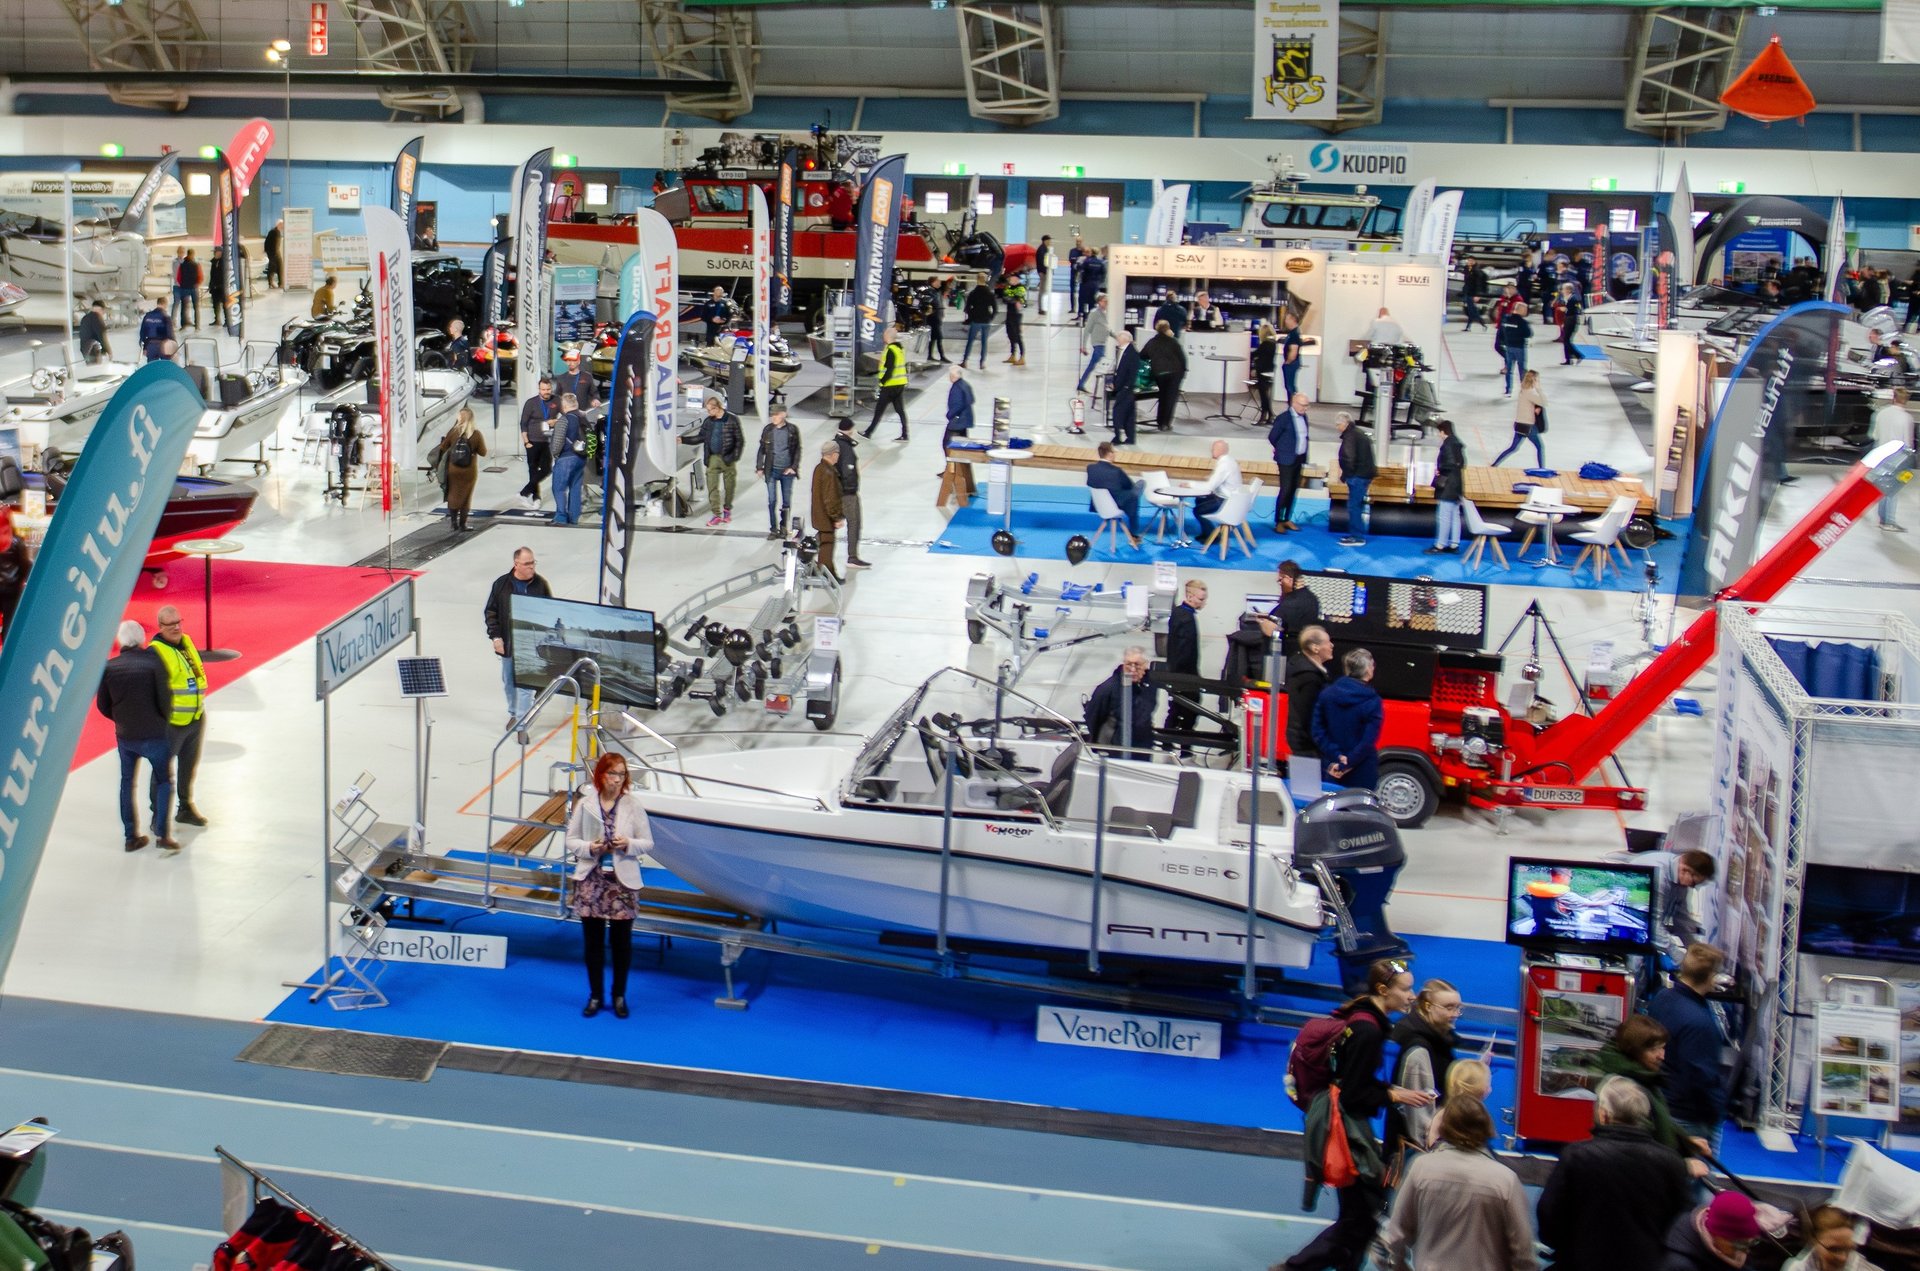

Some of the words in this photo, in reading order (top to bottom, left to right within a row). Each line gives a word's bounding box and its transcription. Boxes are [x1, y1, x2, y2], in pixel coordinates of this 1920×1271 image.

[1263, 75, 1327, 112] KPS
[1343, 155, 1407, 174] KUOPIO
[1175, 254, 1206, 264] SAV
[524, 224, 536, 373] suomiboats.fi
[1704, 440, 1759, 583] AKU
[325, 597, 404, 677] VeneRoller
[1349, 831, 1386, 848] YAMAHA
[1052, 1012, 1202, 1052] VeneRoller
